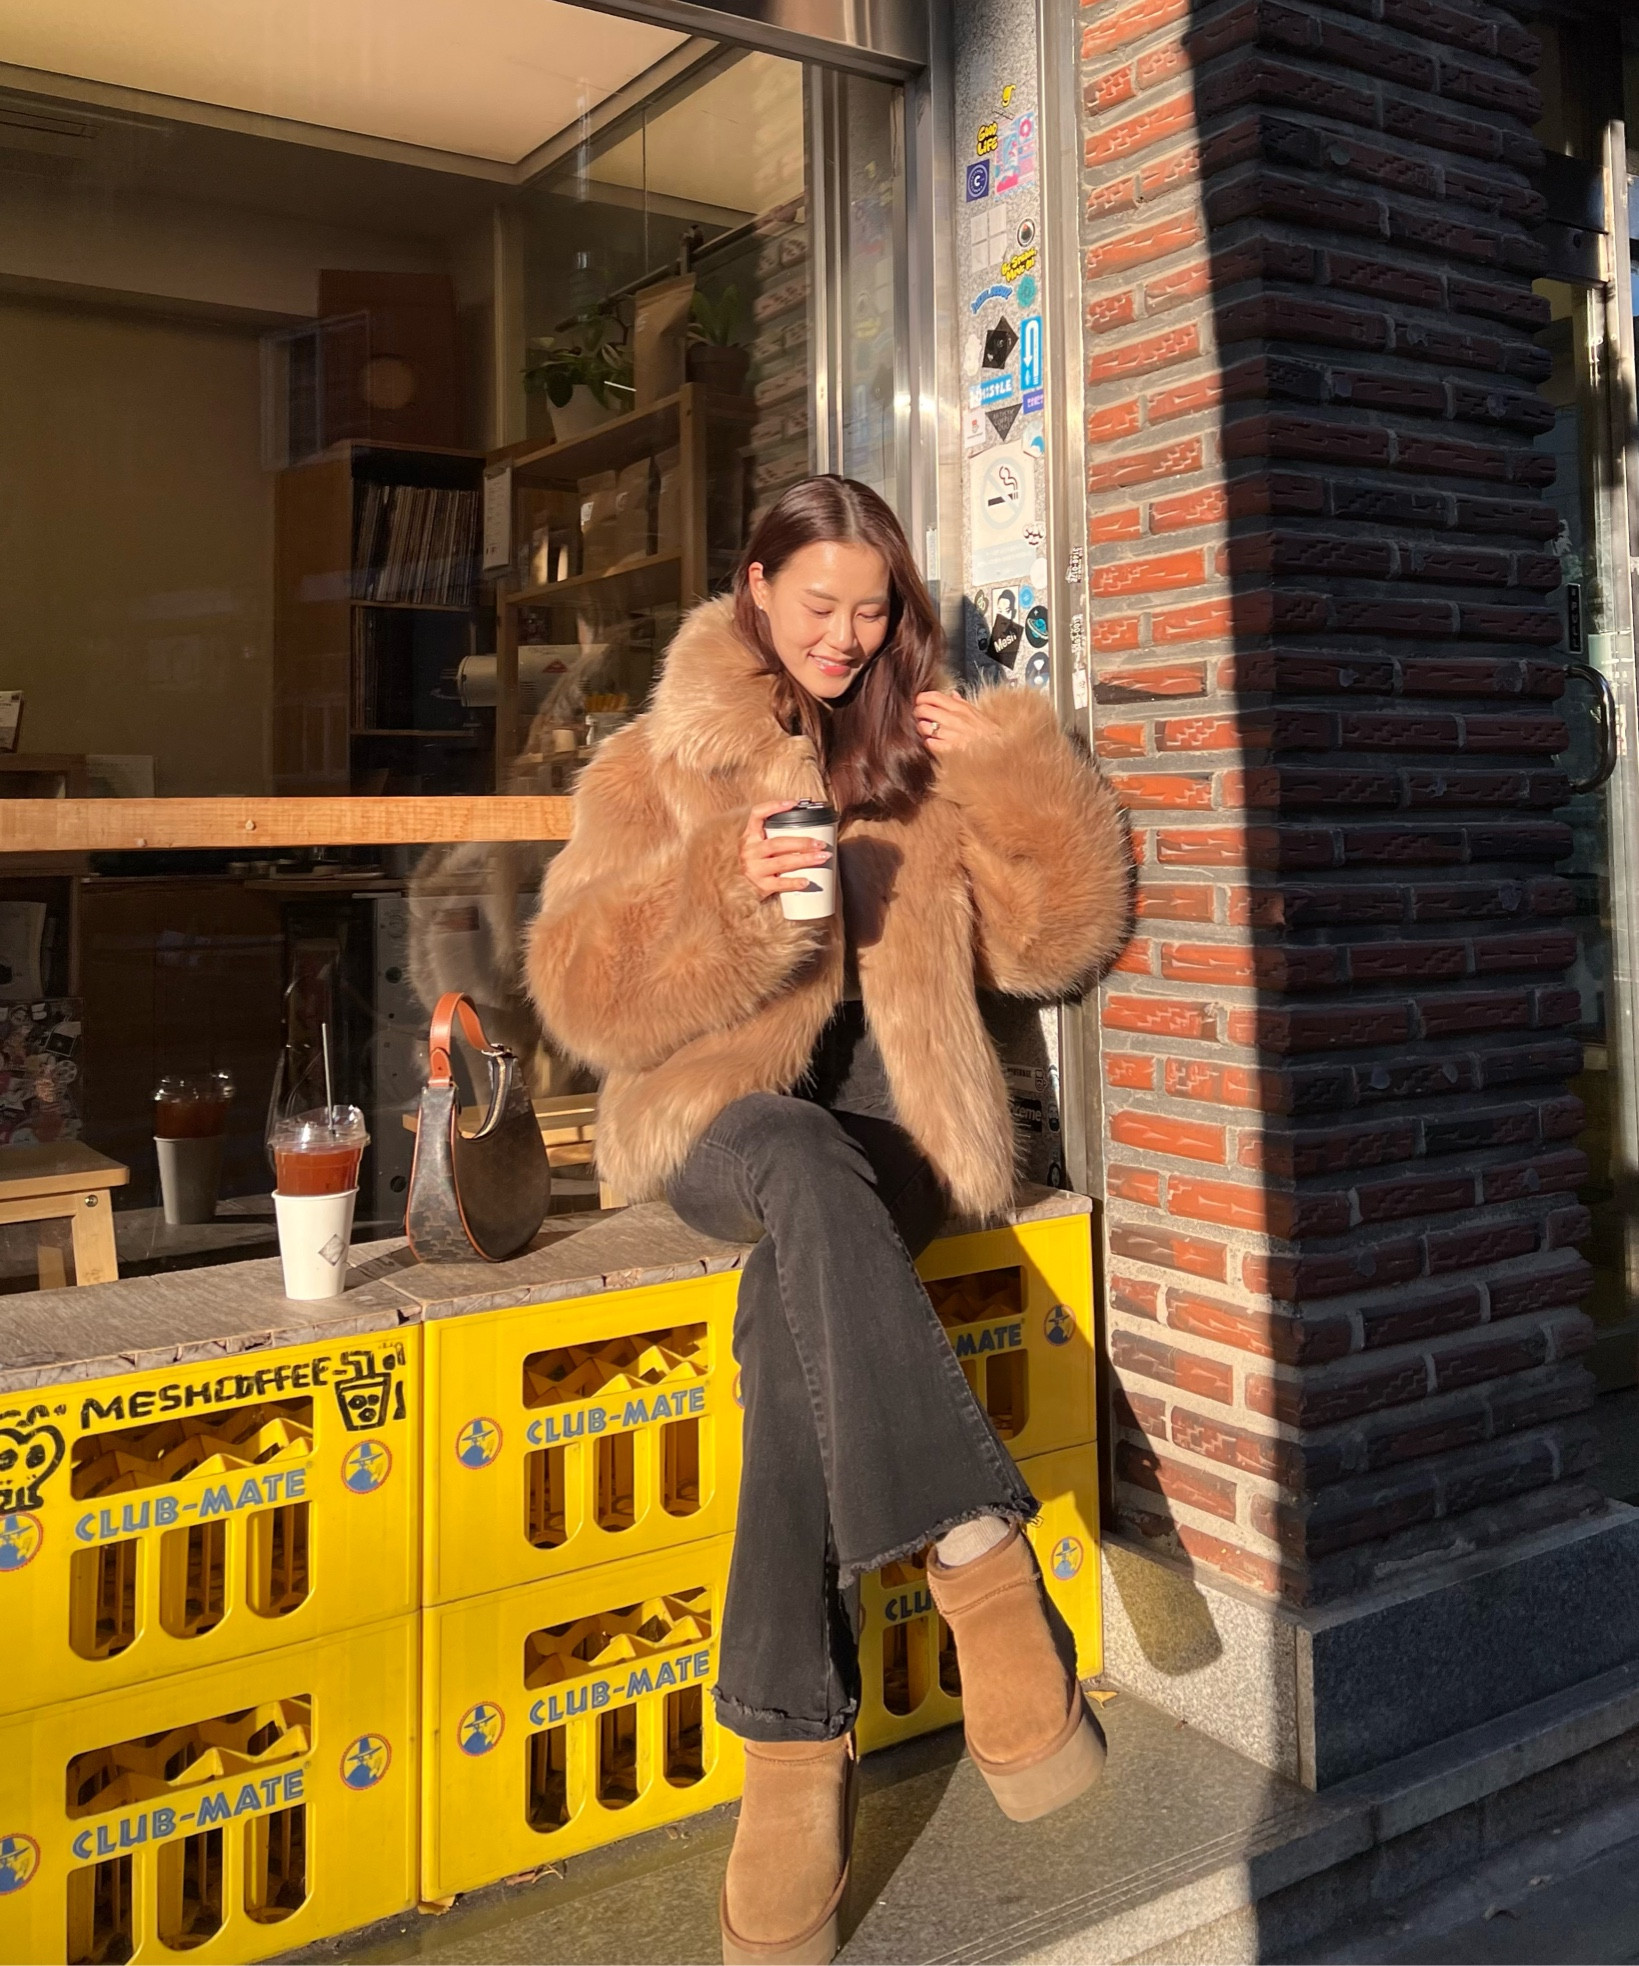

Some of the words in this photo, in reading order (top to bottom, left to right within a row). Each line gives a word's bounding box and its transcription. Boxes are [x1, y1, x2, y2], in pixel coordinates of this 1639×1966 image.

[956, 1323, 1022, 1357] MATE
[526, 1386, 706, 1446] CLUB-MATE
[74, 1467, 308, 1543] CLUB-MATE
[884, 1587, 933, 1622] CLU
[528, 1649, 711, 1727] CLUB-MATE
[72, 1768, 306, 1861] CLUB-MATE
